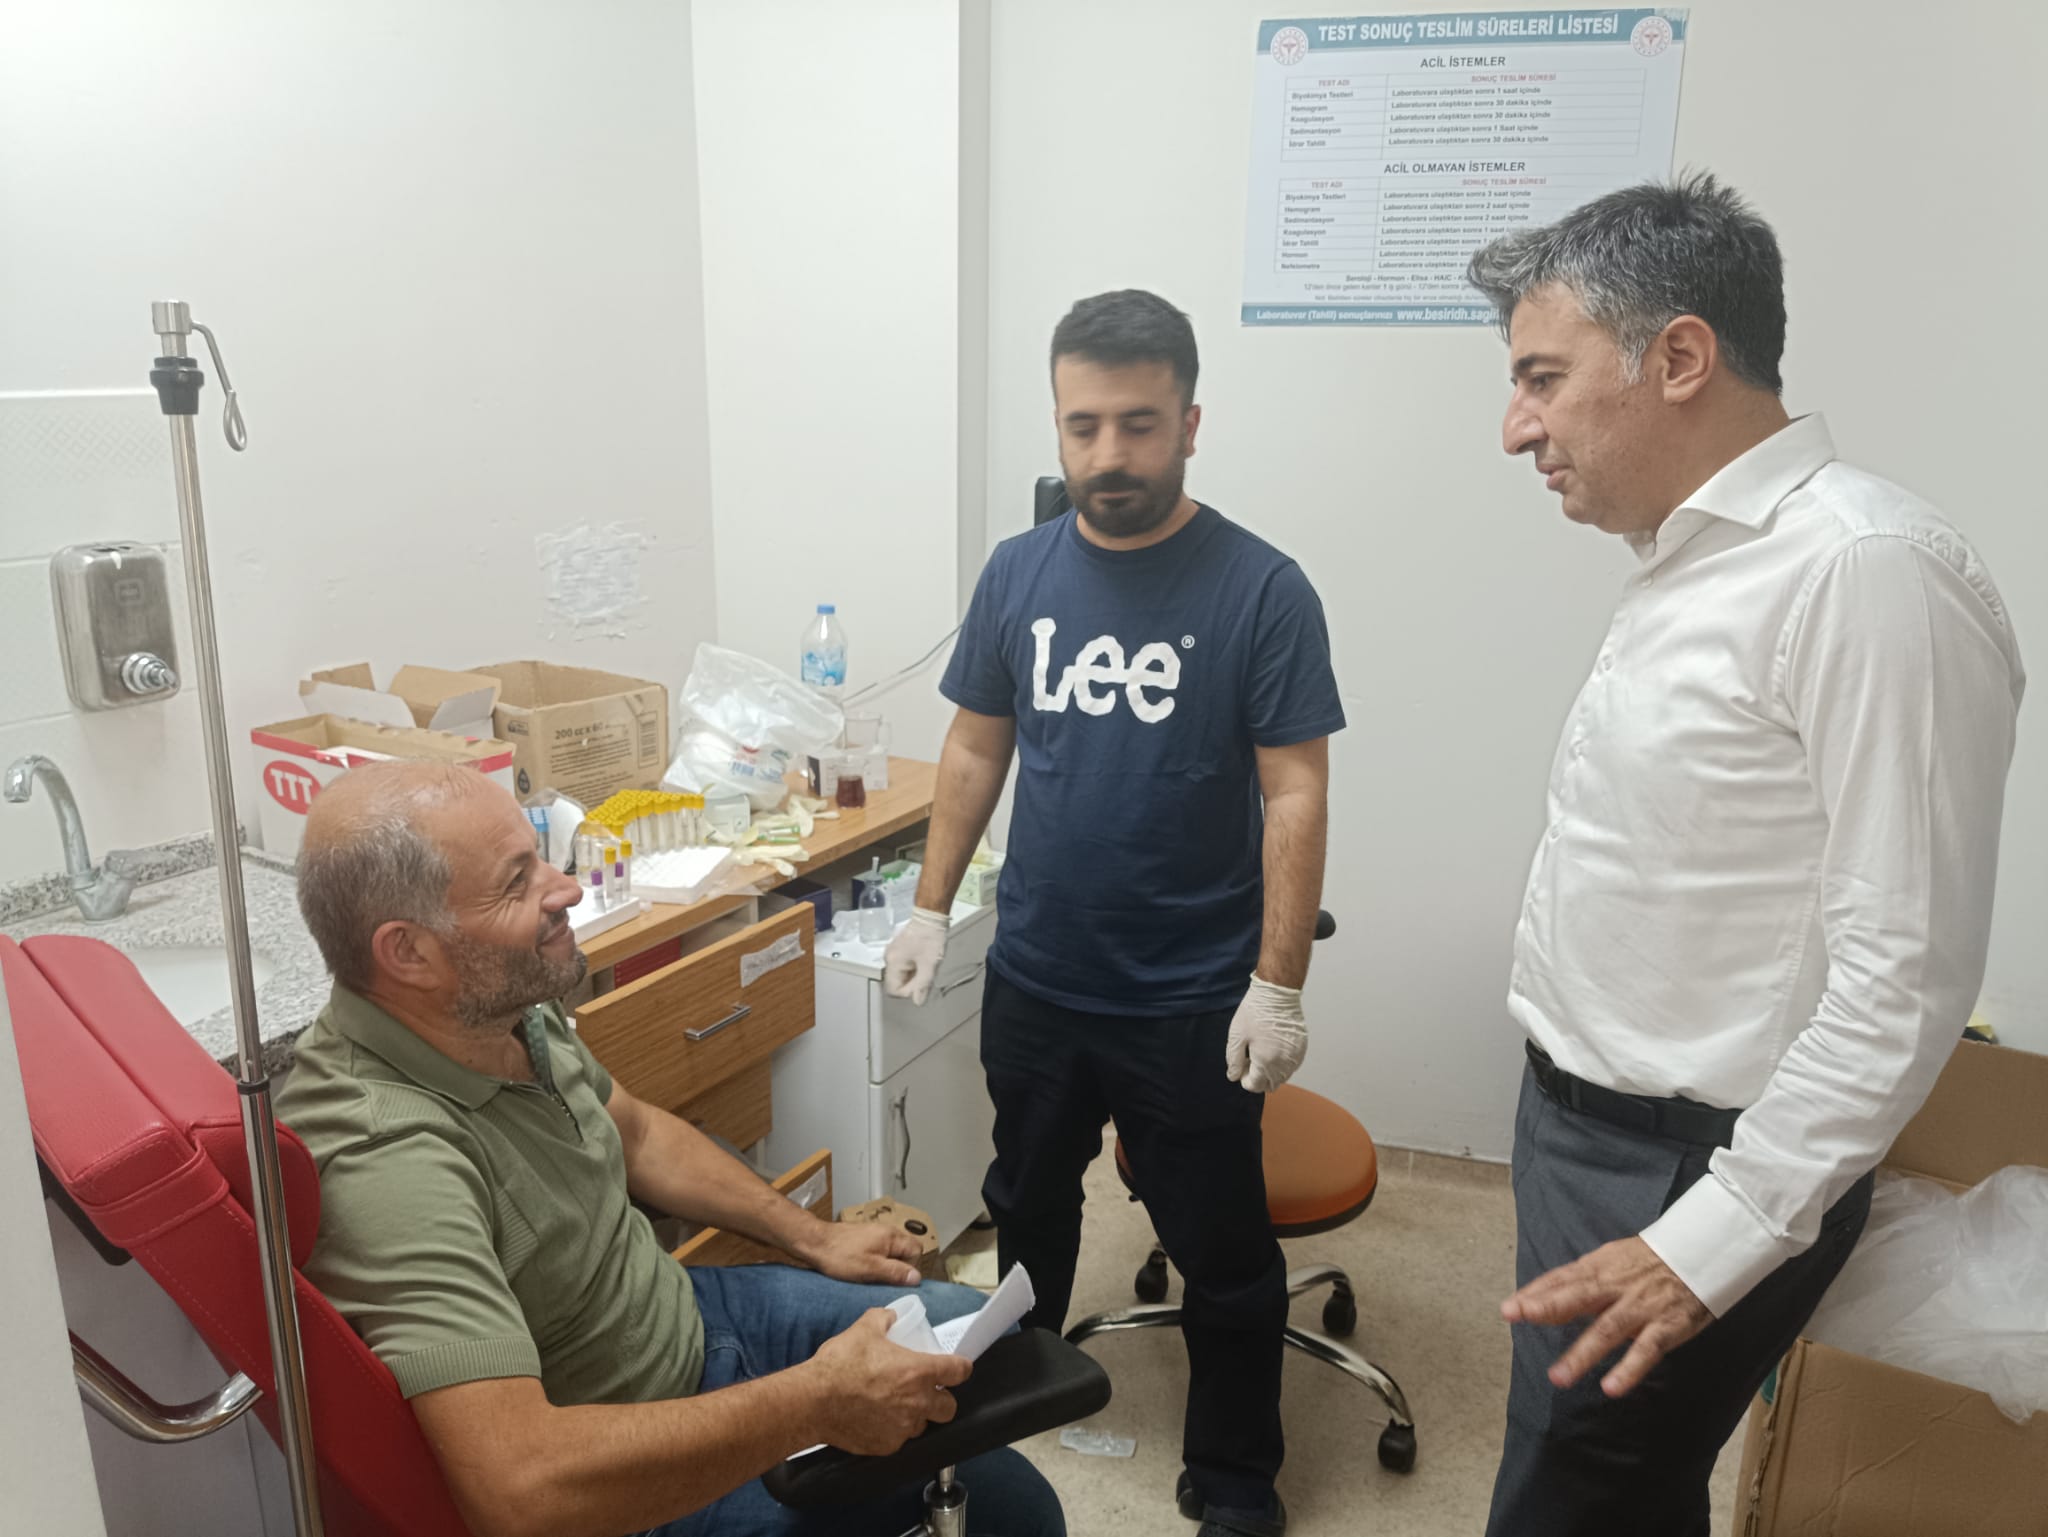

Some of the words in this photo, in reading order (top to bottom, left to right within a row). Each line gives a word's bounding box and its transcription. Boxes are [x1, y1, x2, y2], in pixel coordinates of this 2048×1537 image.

[1318, 24, 1356, 41] TEST
[1360, 22, 1413, 43] SONUÇ
[1418, 17, 1473, 38] TESLİM
[1477, 15, 1554, 37] SÜRELERİ
[1558, 14, 1619, 36] LİSTESİ
[1420, 56, 1446, 68] ACİL
[1449, 55, 1506, 67] İSTEMLER
[1471, 75, 1498, 83] SONUÇ
[1392, 88, 1438, 96] Laboratuvara
[1520, 87, 1541, 95] içinde
[1391, 101, 1437, 109] Laboratuvara
[1530, 99, 1552, 107] içinde
[1391, 113, 1436, 121] Laboratuvara
[1529, 111, 1551, 120] içinde
[1390, 126, 1435, 134] Laboratuvara
[1517, 124, 1538, 132] içinde
[1527, 136, 1549, 144] içinde
[1384, 161, 1409, 174] ACİL
[1412, 162, 1466, 173] OLMAYAN
[1469, 160, 1525, 172] İSTEMLER
[1462, 178, 1488, 187] SONUÇ
[1384, 191, 1429, 199] Laboratuvara
[1510, 190, 1531, 198] içinde
[1383, 203, 1428, 211] Laboratuvara
[1508, 202, 1530, 210] içinde
[1507, 214, 1529, 222] içinde
[1382, 226, 1426, 234] Laboratuvara
[1381, 238, 1425, 246] Laboratuvara
[1256, 310, 1306, 320] Laboratuvar
[1031, 617, 1181, 724] Lee
[555, 727, 573, 740] 200
